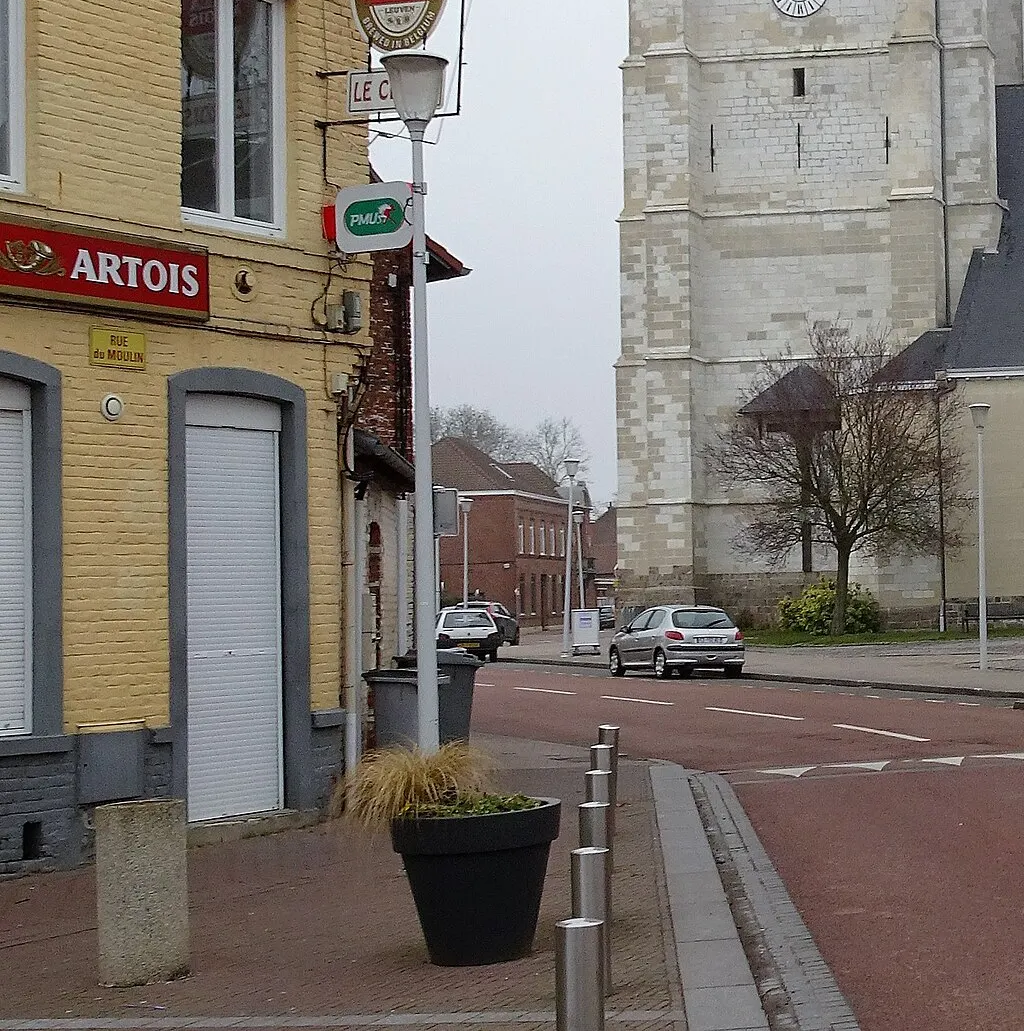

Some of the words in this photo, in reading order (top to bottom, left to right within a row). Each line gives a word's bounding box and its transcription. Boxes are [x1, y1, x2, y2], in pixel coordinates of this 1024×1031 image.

[362, 16, 390, 47] BREWED
[392, 40, 402, 49] IN
[404, 10, 436, 47] BELGIUM
[354, 80, 372, 103] LE
[350, 212, 379, 227] PMU
[70, 248, 199, 297] ARTOIS
[110, 334, 128, 347] RUE
[107, 349, 144, 364] MOULIN
